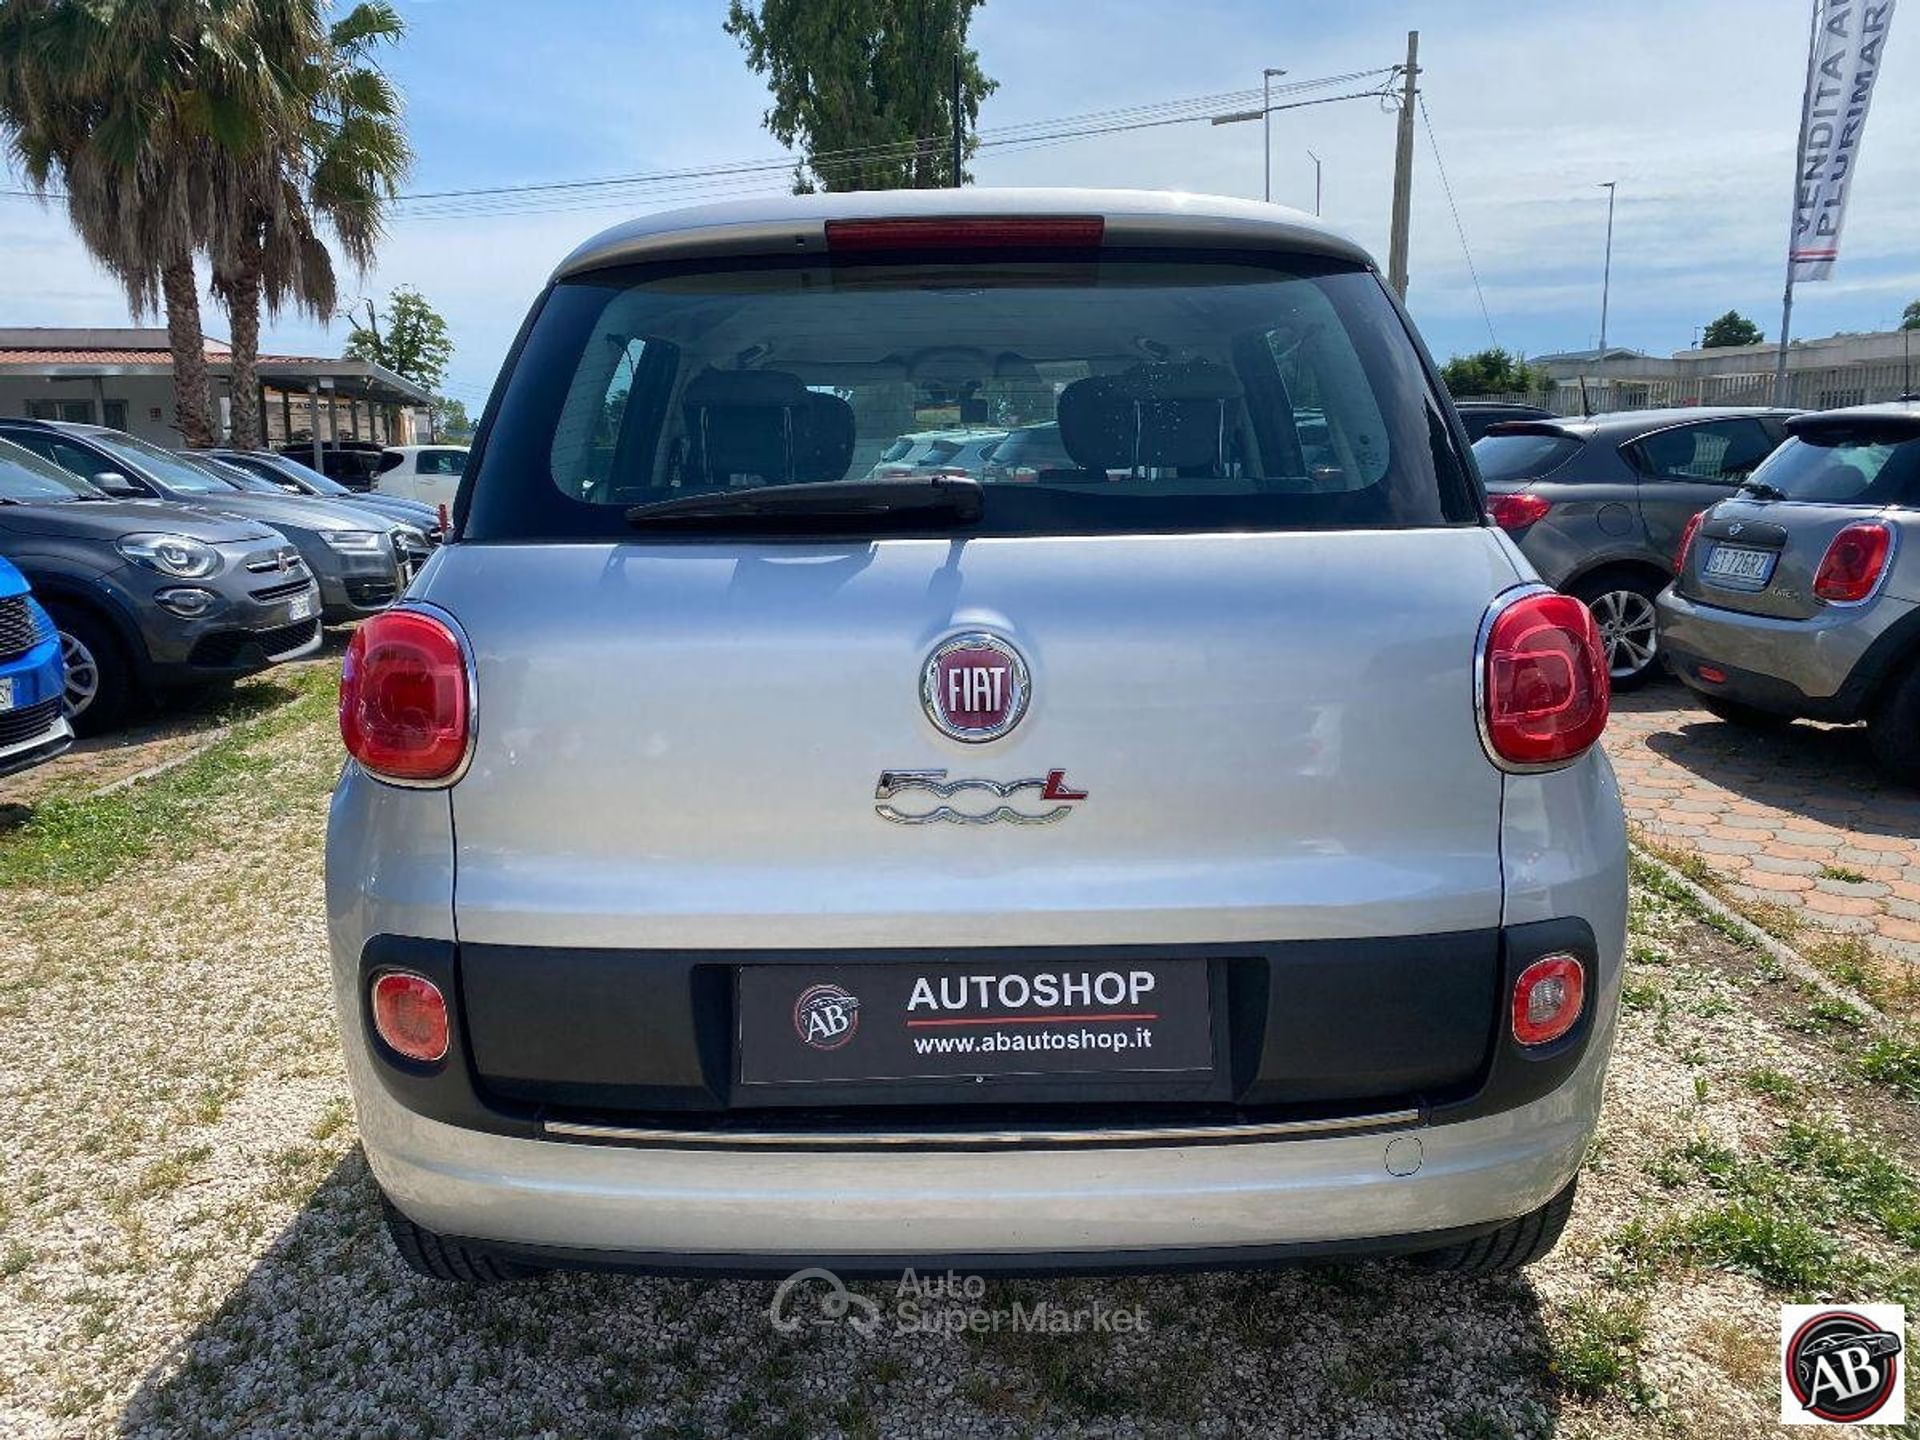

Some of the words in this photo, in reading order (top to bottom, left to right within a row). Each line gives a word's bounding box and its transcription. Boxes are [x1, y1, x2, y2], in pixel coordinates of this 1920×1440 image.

[1815, 1, 1890, 236] PLURIMAR
[1797, 48, 1846, 236] VENDITA
[948, 667, 1006, 712] FIAT
[874, 767, 1089, 826] 500L
[906, 970, 1156, 1011] AUTOSHOP
[804, 1004, 849, 1043] AB
[913, 1026, 1153, 1054] www.abautoshop.it
